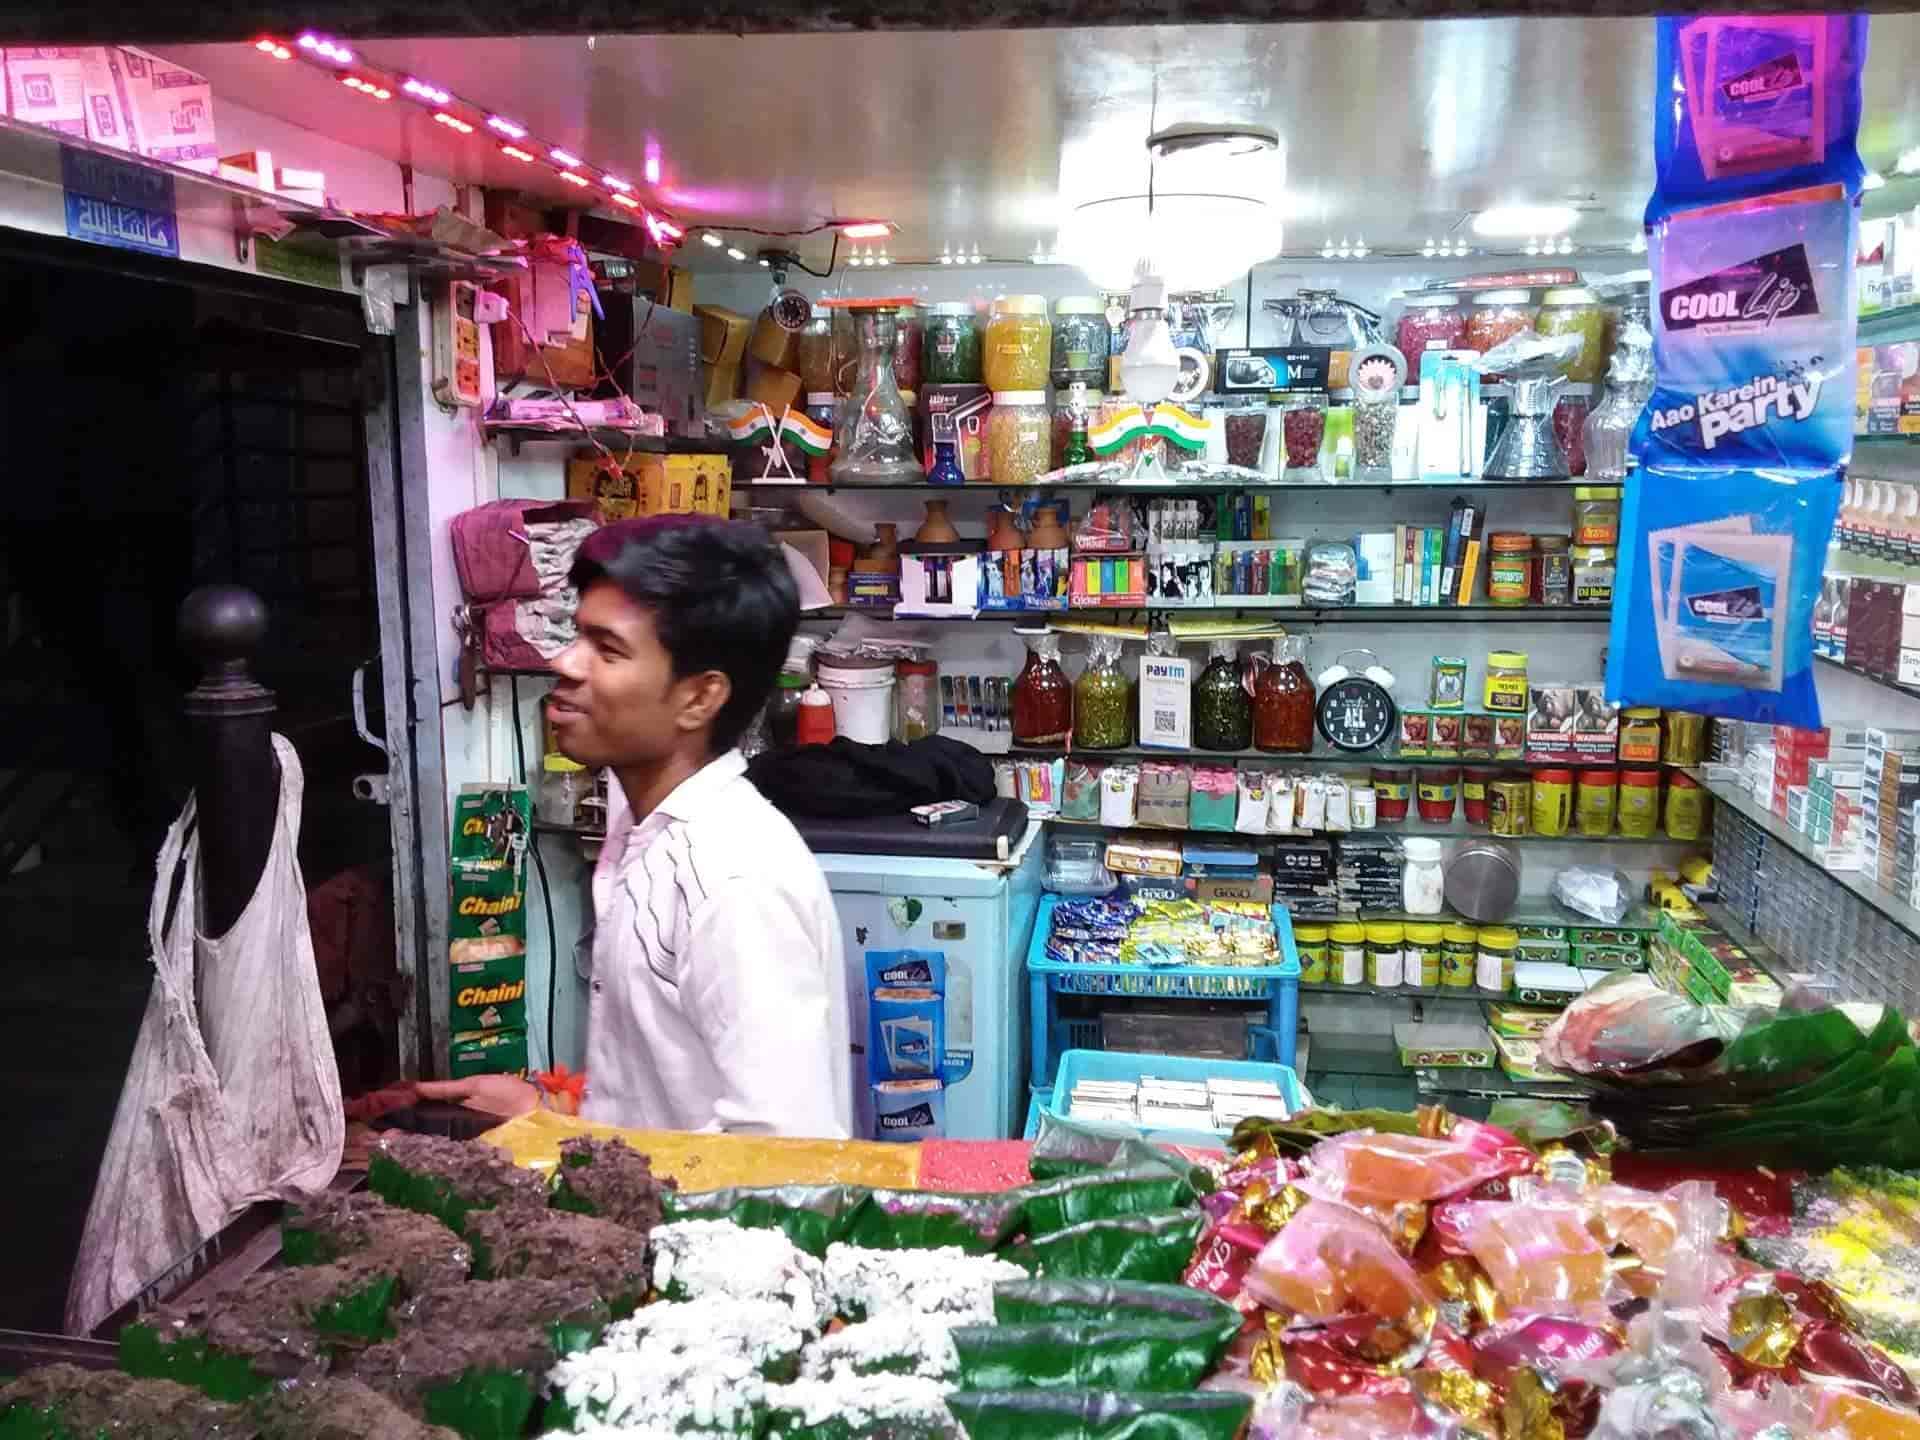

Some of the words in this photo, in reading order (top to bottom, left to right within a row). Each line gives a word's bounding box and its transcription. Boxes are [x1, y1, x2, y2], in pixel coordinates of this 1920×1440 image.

[1669, 289, 1740, 322] COOL
[1742, 273, 1800, 327] Lip
[1650, 402, 1695, 433] Aao
[1698, 374, 1779, 416] Karein
[459, 893, 522, 915] Chaini
[457, 979, 525, 1008] Chaini
